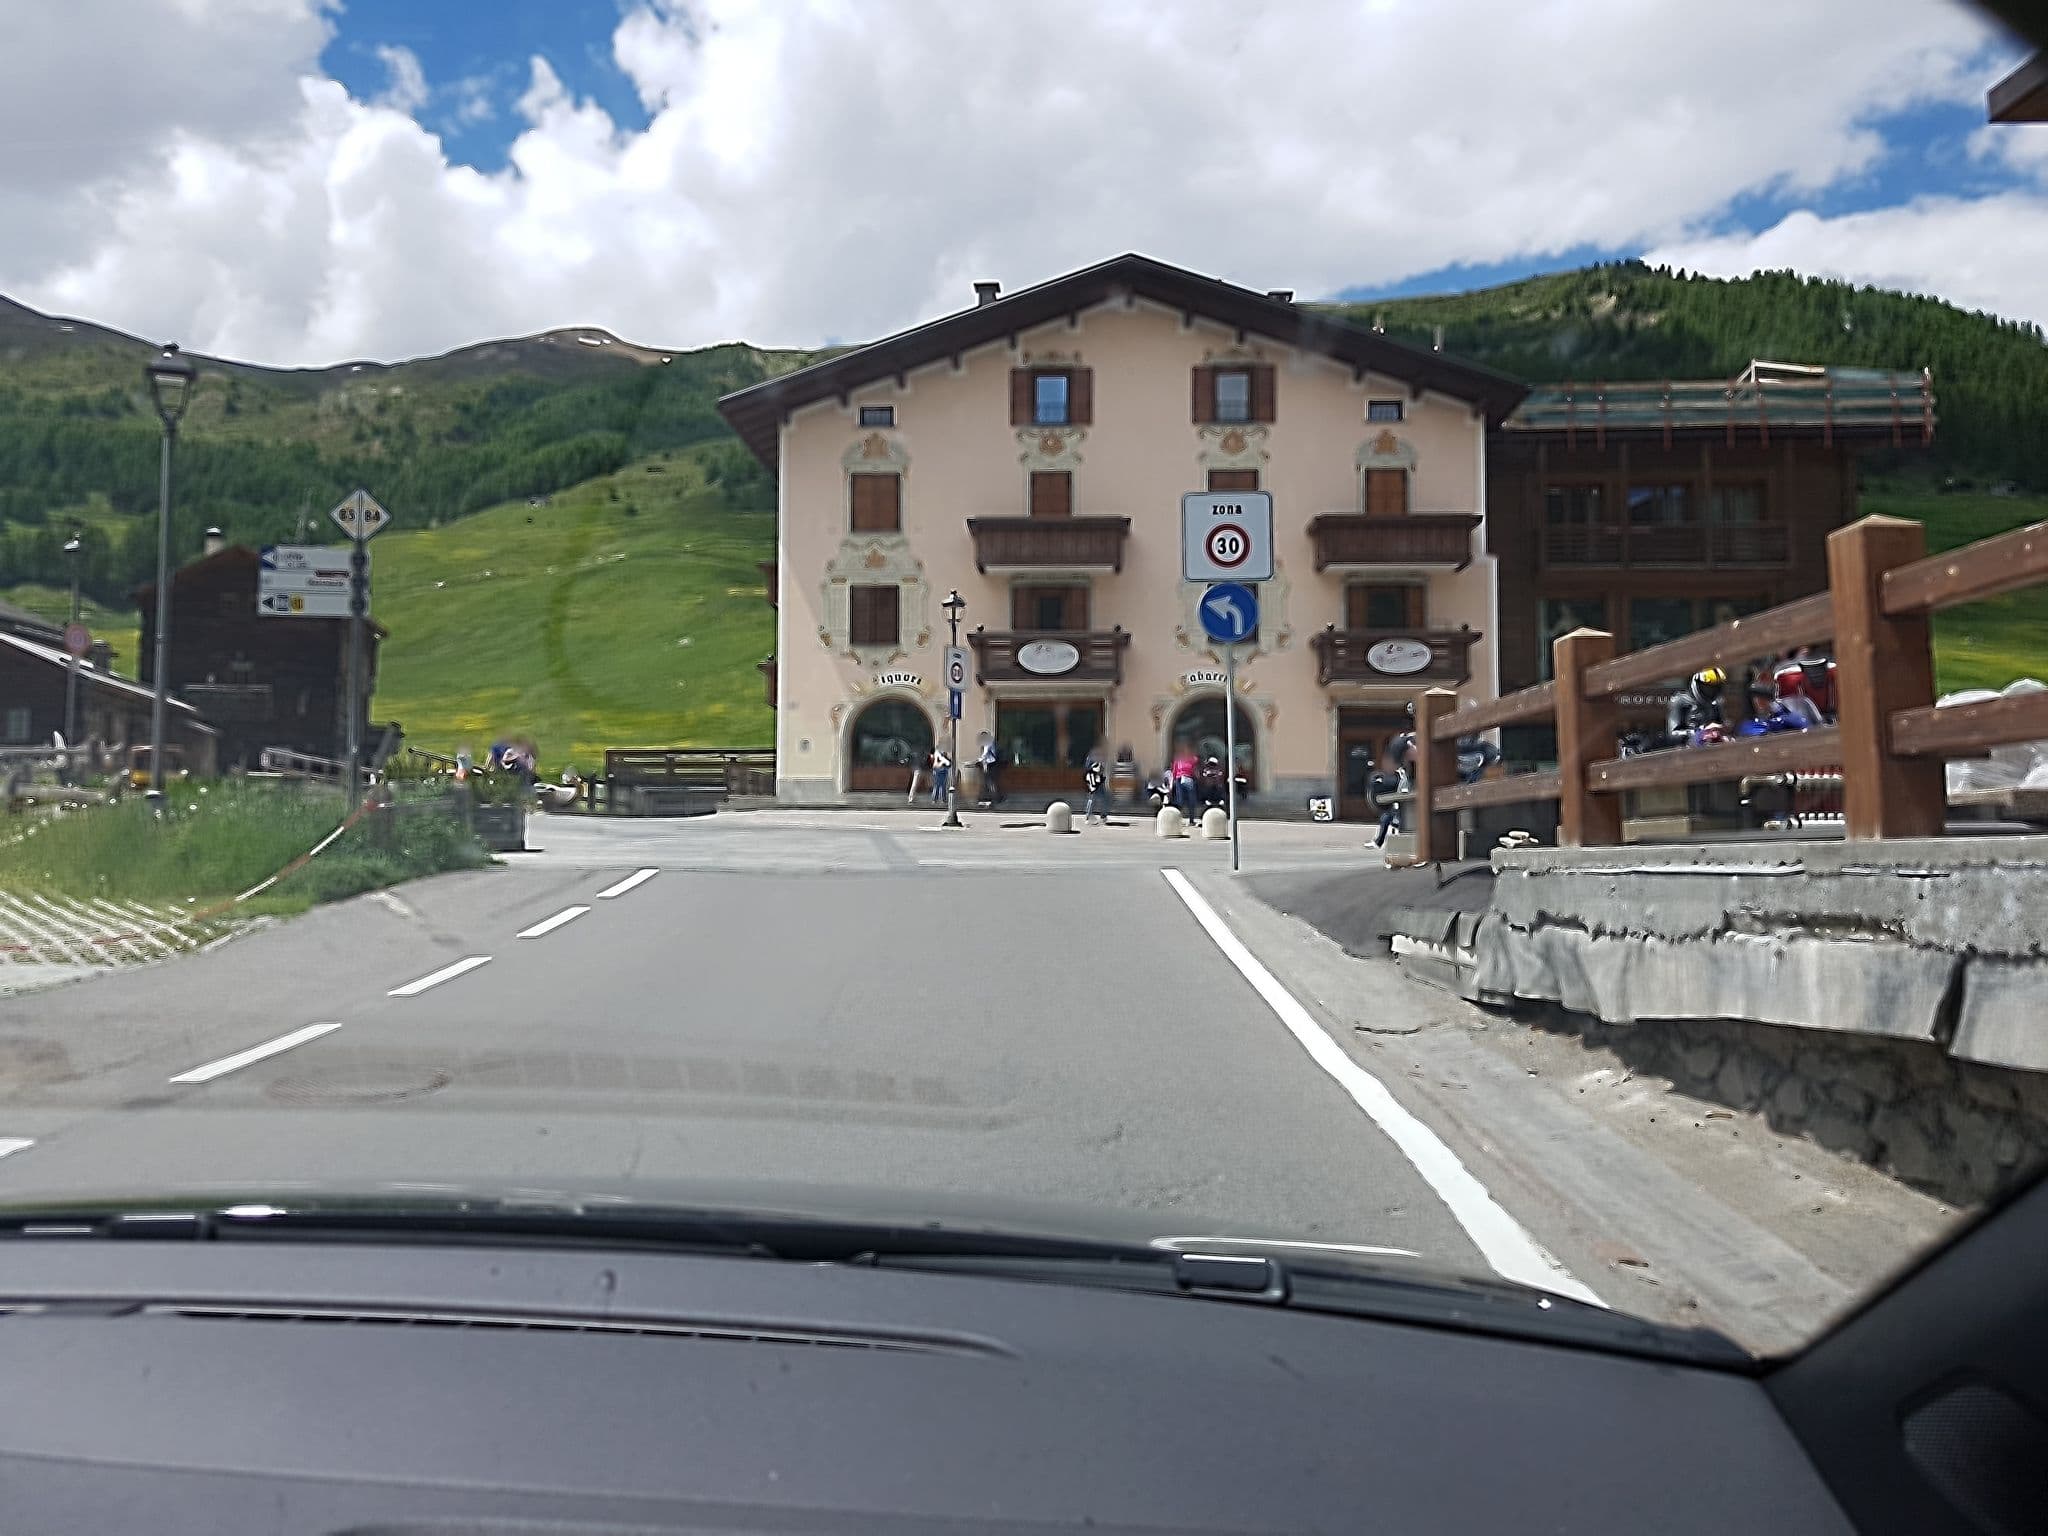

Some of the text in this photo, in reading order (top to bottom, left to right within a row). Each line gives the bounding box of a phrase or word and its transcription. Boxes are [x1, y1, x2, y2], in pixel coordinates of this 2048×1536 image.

[1212, 504, 1242, 515] zona
[1217, 537, 1240, 555] 30
[874, 672, 922, 685] iquori
